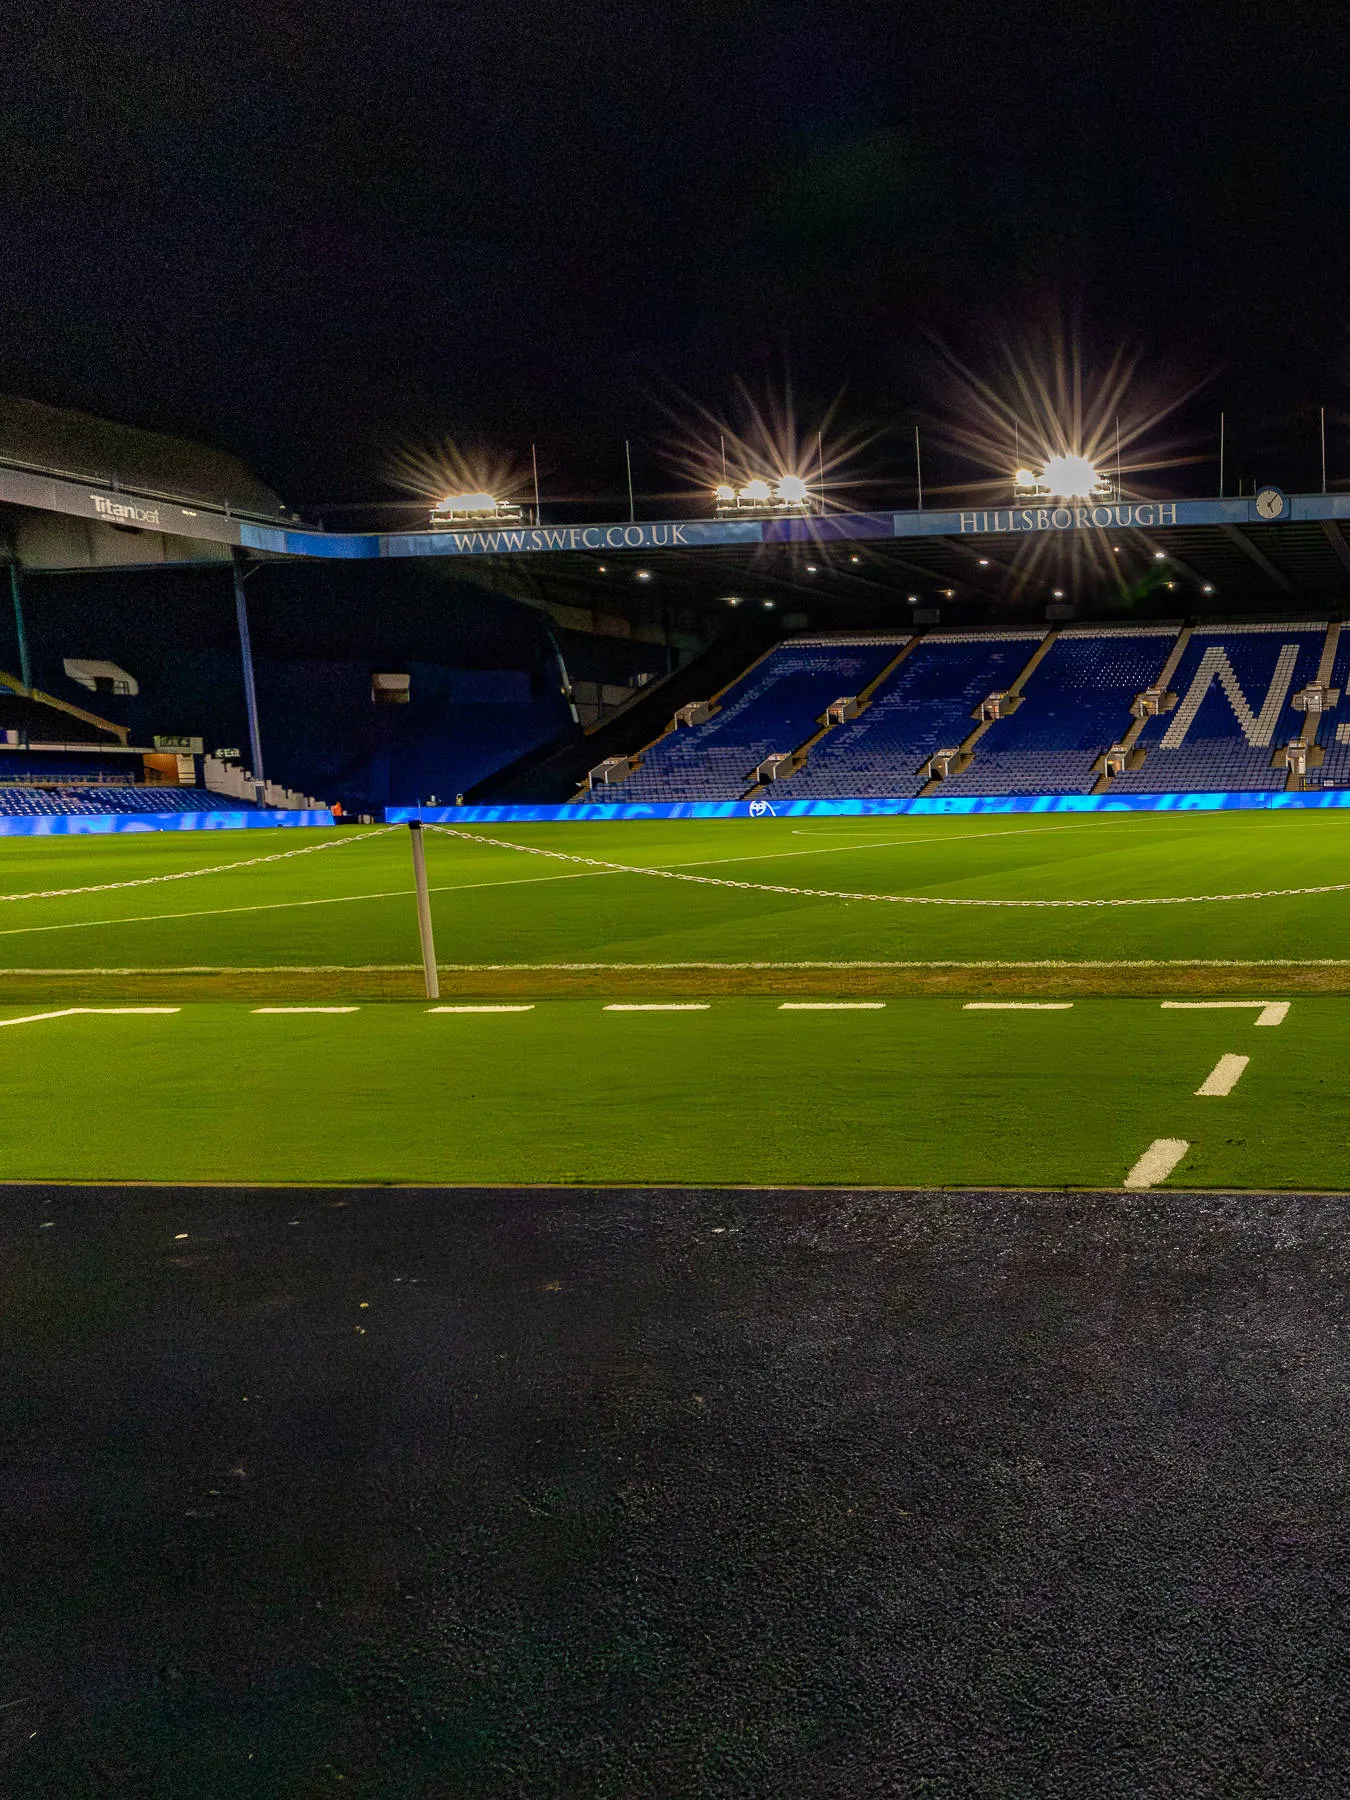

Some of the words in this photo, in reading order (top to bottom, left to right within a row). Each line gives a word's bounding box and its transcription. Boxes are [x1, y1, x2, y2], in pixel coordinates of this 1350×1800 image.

[90, 494, 160, 524] Titanbet
[959, 503, 1177, 533] HILLSBOROUGH
[453, 524, 689, 553] WWW.SWFC.CO.UK
